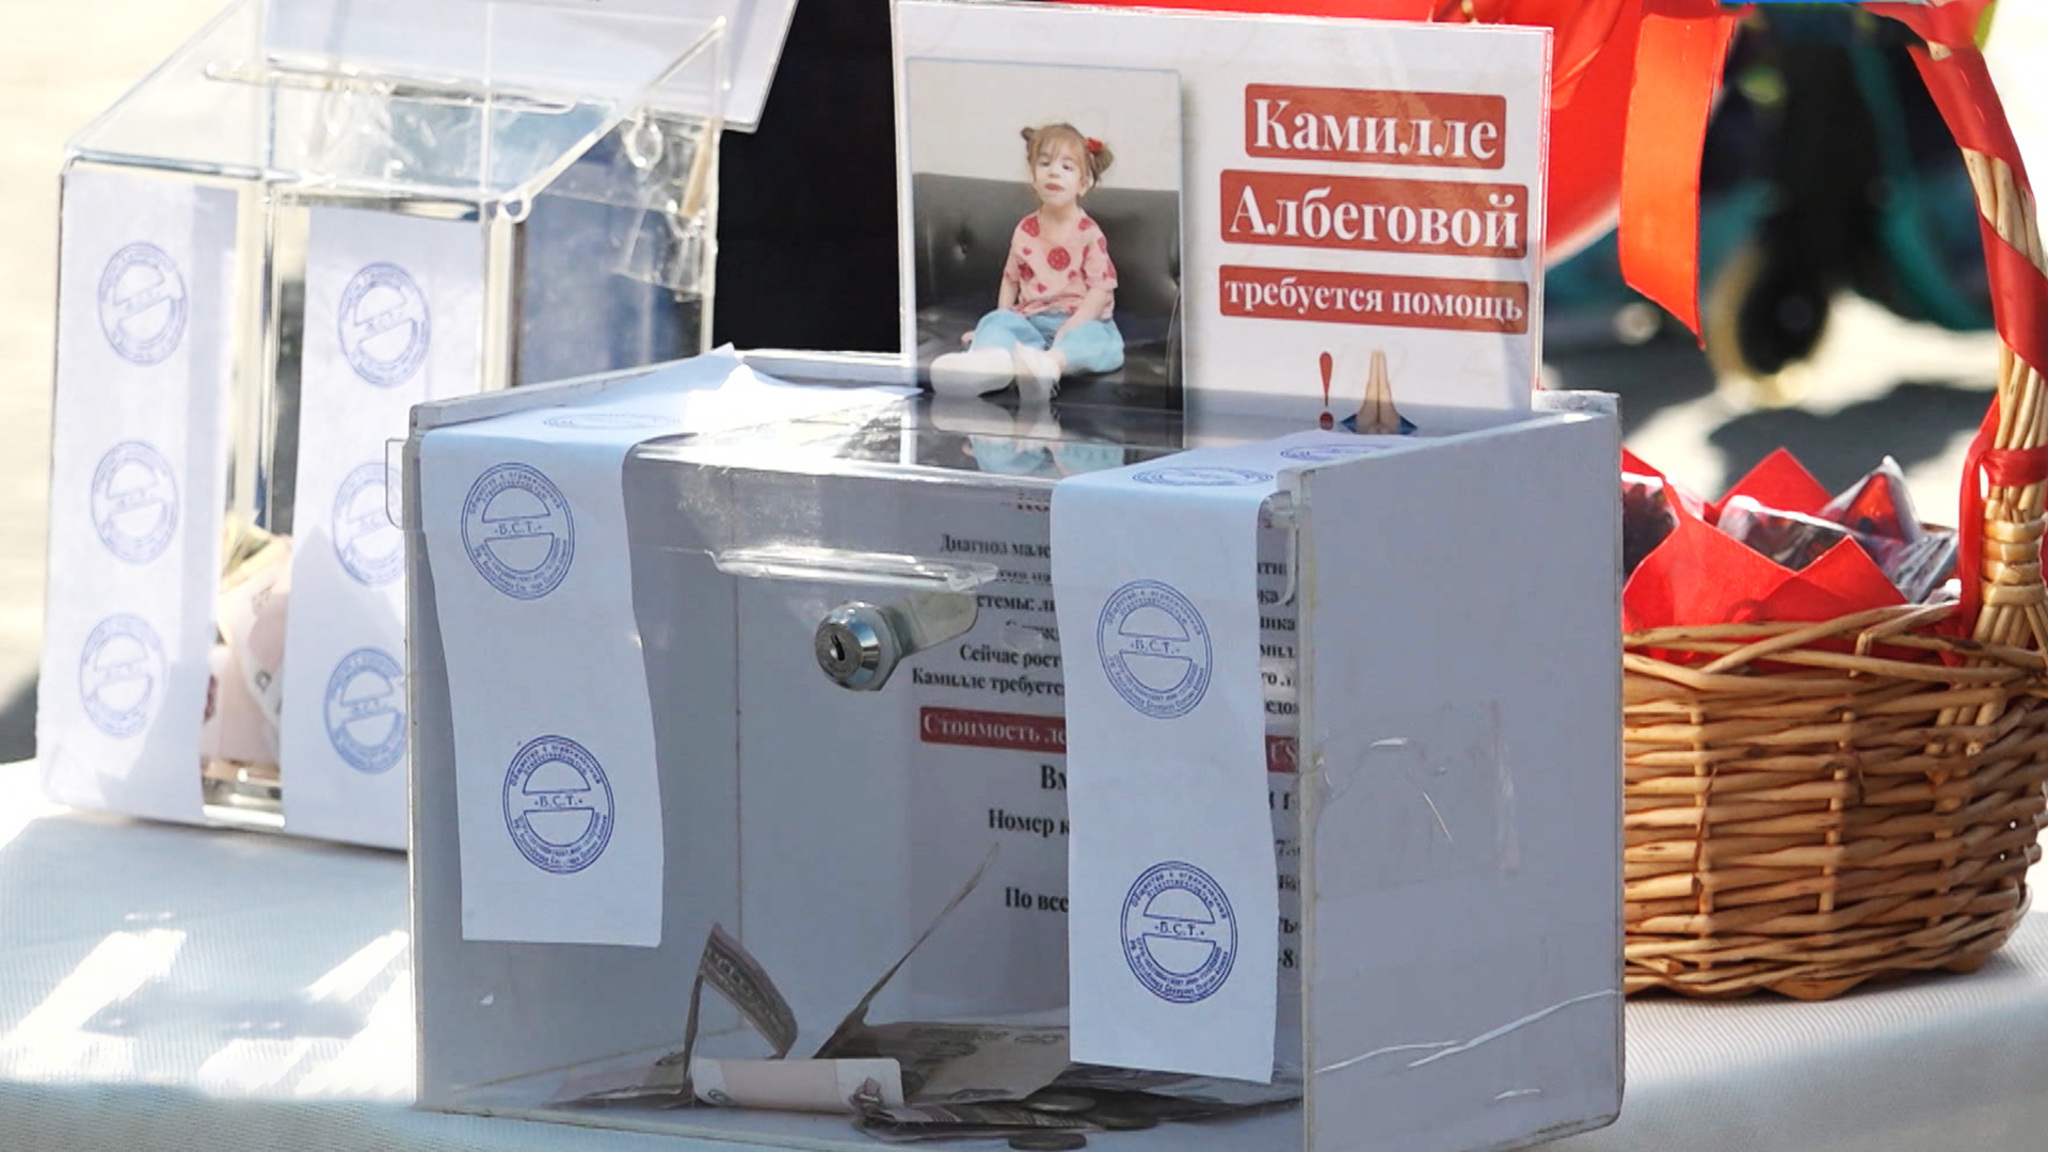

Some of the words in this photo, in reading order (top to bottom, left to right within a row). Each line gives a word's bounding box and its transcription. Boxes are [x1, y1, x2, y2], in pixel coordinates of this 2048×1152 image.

[1254, 98, 1498, 160] Камилле
[1230, 184, 1518, 249] Албеговой
[1224, 277, 1384, 315] требуется
[1393, 291, 1522, 322] помощь
[940, 534, 1008, 555] Диагноз
[960, 644, 1018, 665] Сейчас
[912, 667, 986, 689] Камилле
[923, 714, 1040, 742] Стоимость
[988, 808, 1055, 838] Номер
[1004, 887, 1032, 910] По
